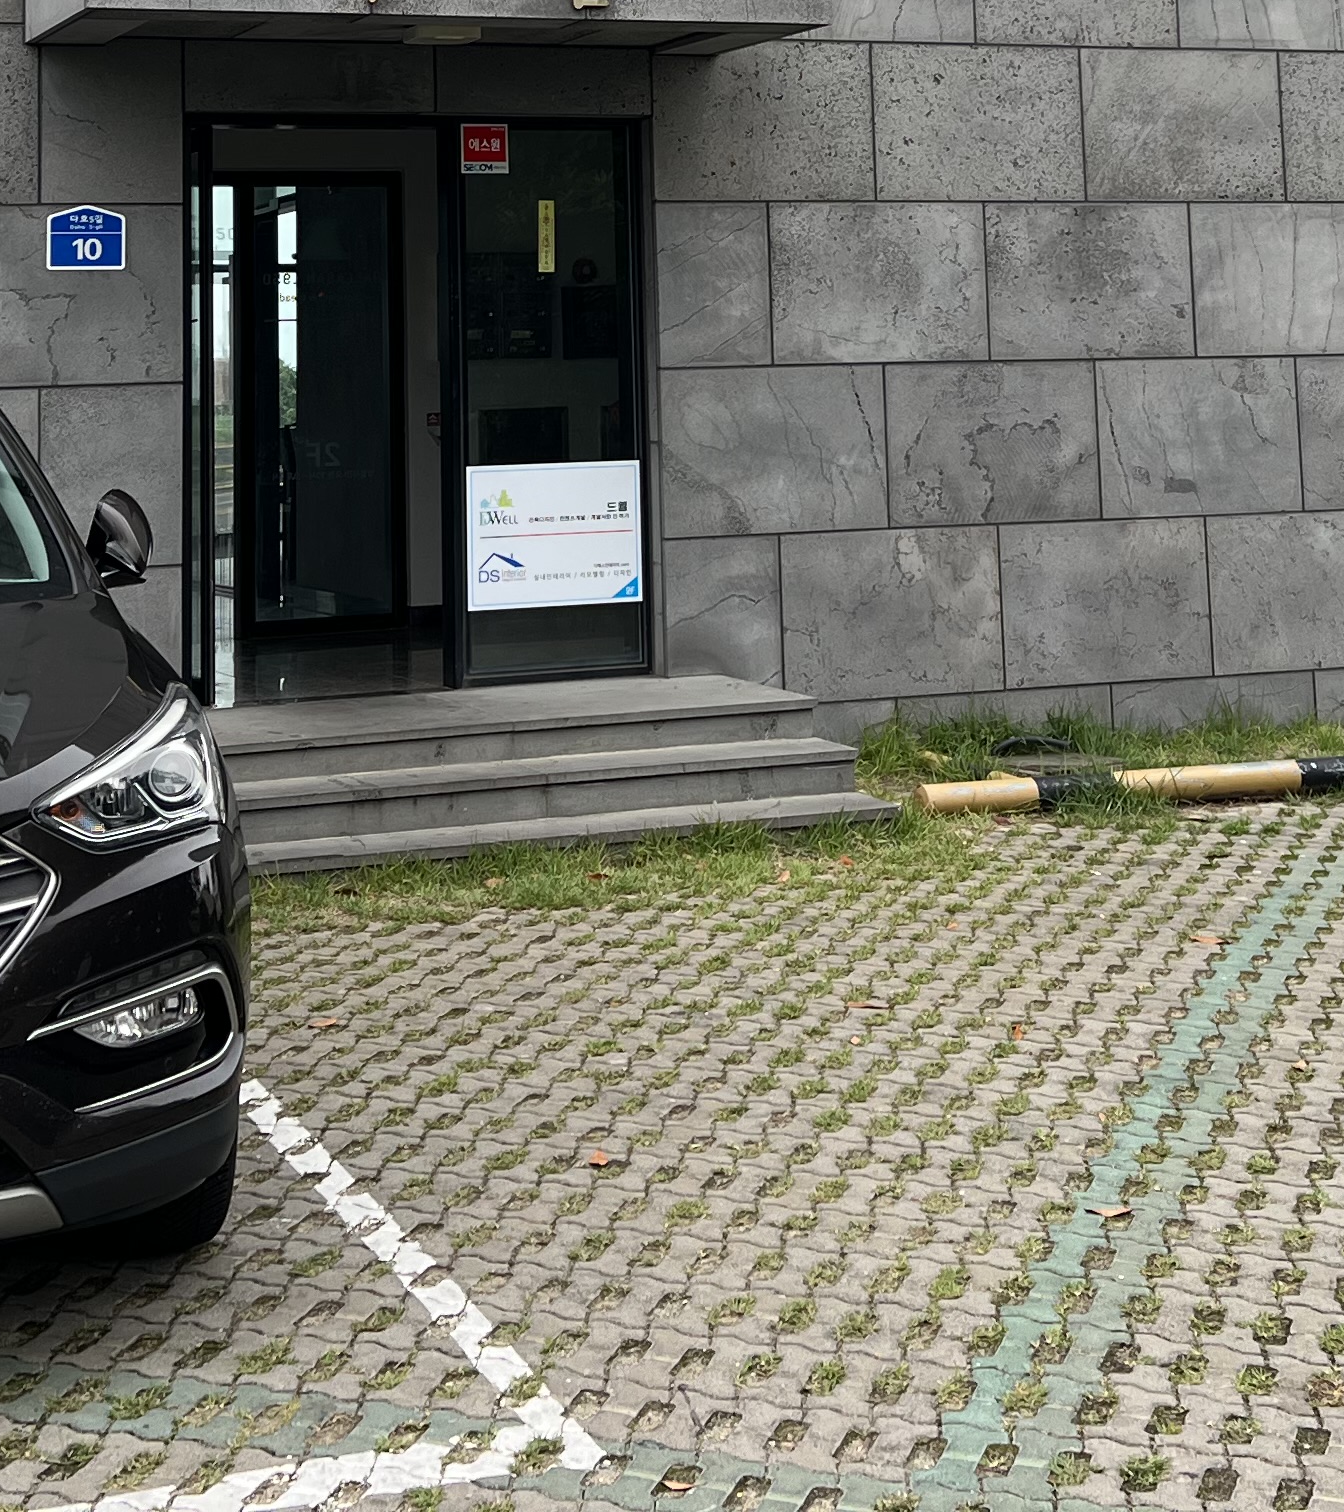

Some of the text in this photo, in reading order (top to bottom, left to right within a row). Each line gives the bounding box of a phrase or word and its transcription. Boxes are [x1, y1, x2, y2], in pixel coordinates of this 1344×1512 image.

[468, 137, 501, 152] 에스원
[464, 163, 493, 172] SECOM
[72, 238, 103, 261] 10
[478, 569, 500, 584] DS
